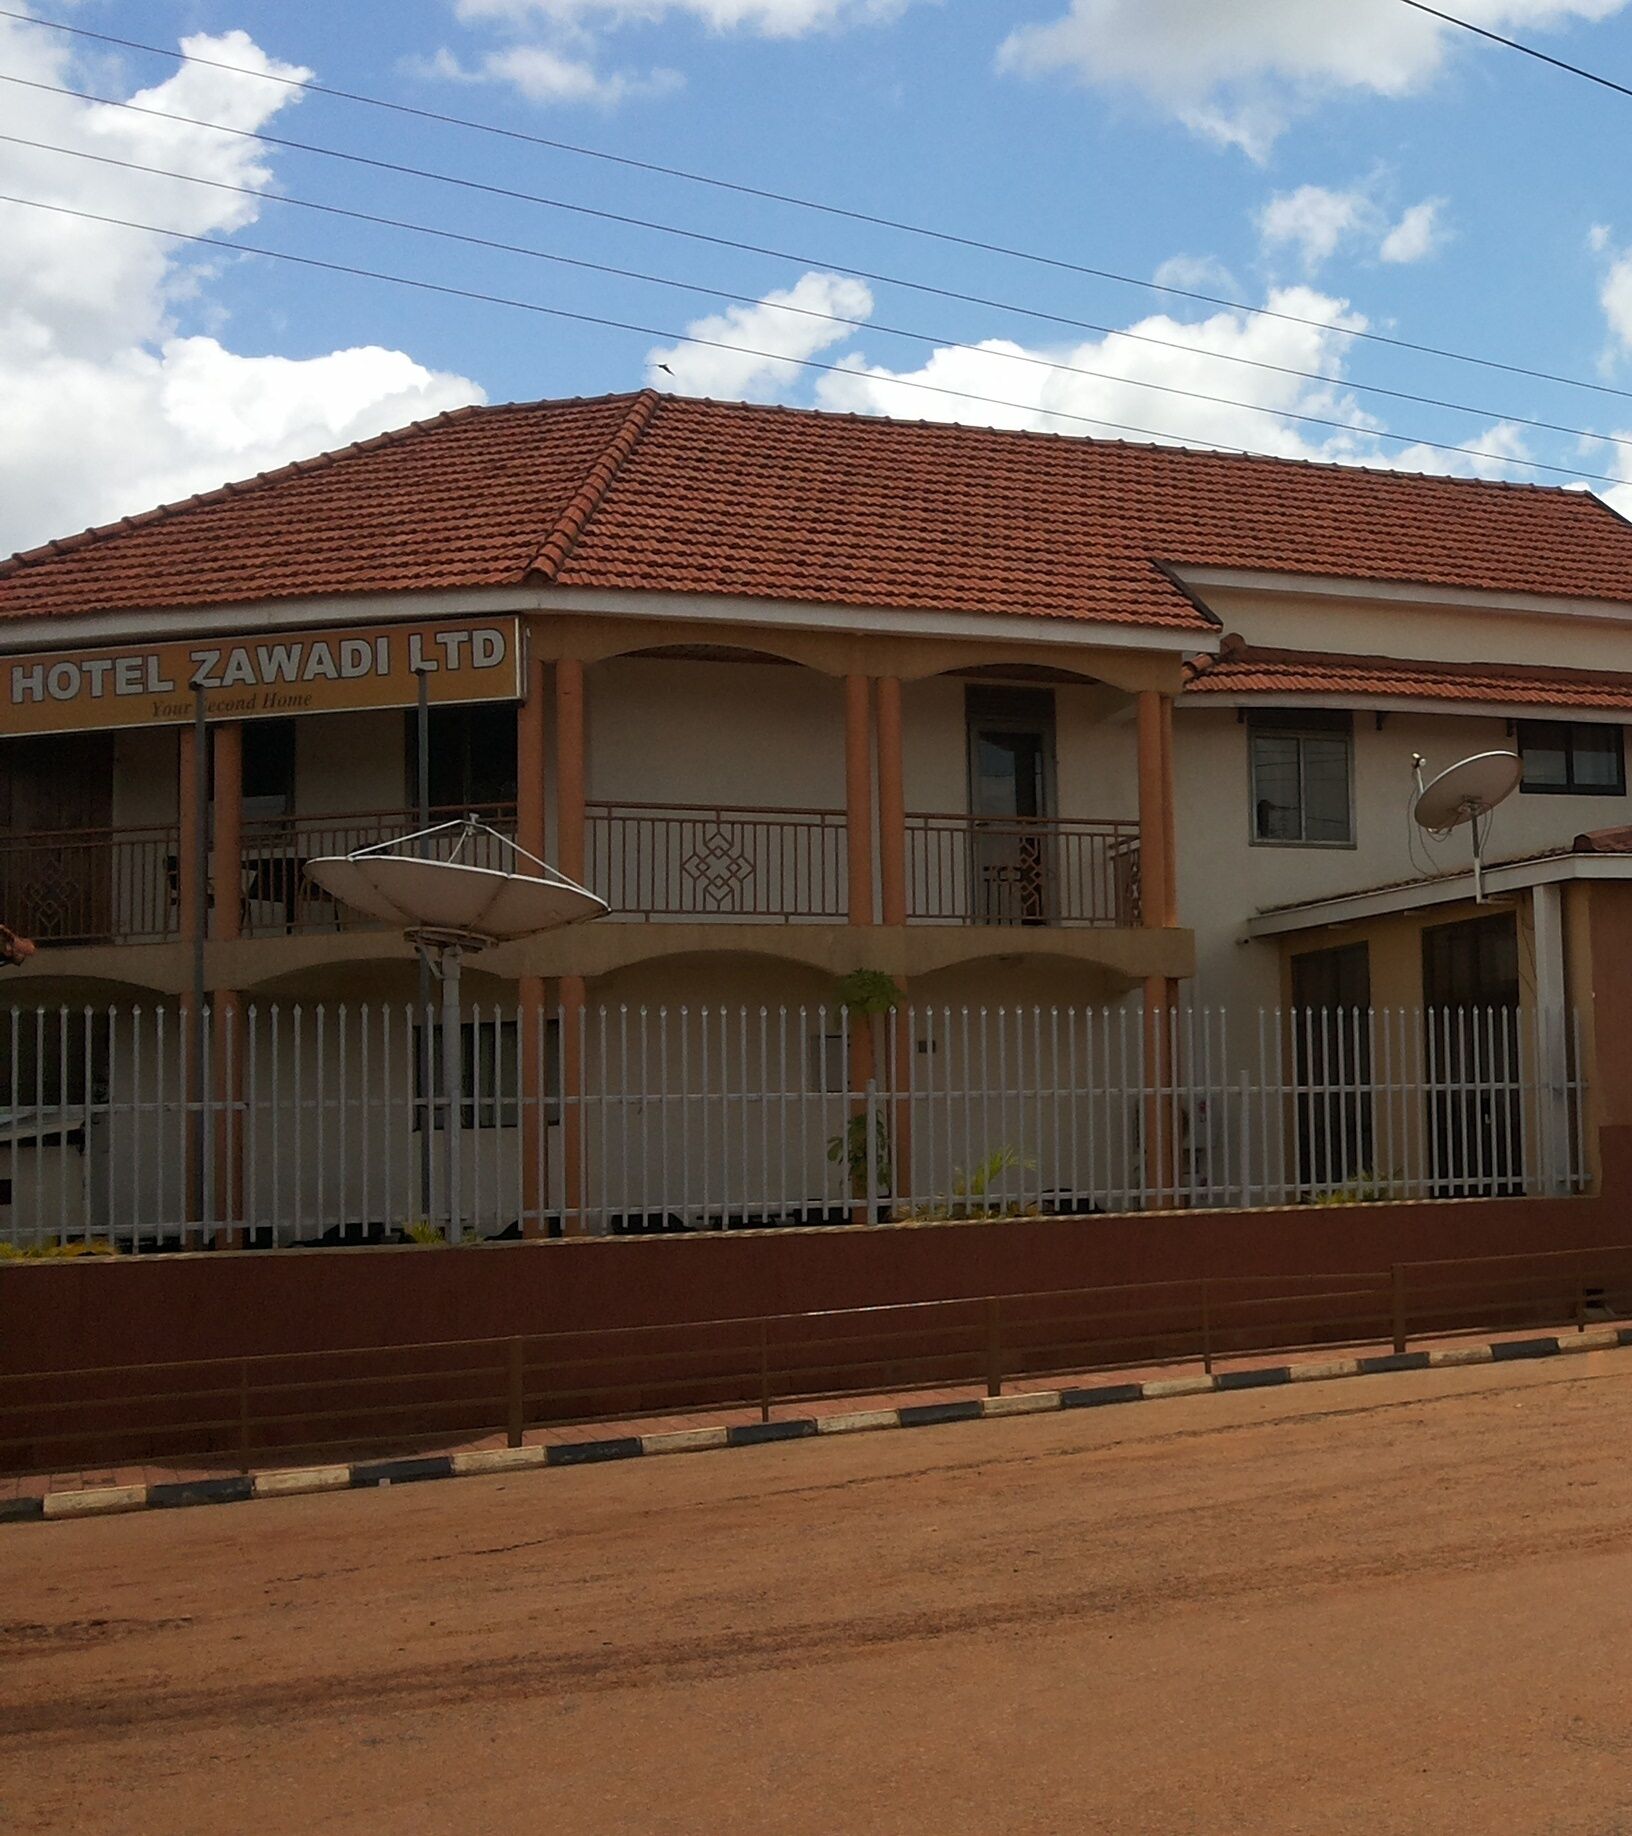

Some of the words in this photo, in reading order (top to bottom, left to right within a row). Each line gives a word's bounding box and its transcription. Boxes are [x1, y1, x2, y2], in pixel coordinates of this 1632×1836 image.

[11, 655, 174, 704] HOTEL
[189, 635, 389, 689] ZAWADI
[409, 628, 506, 673] LTD
[152, 701, 193, 717] Your
[204, 692, 257, 713] econd
[262, 692, 312, 710] Home
